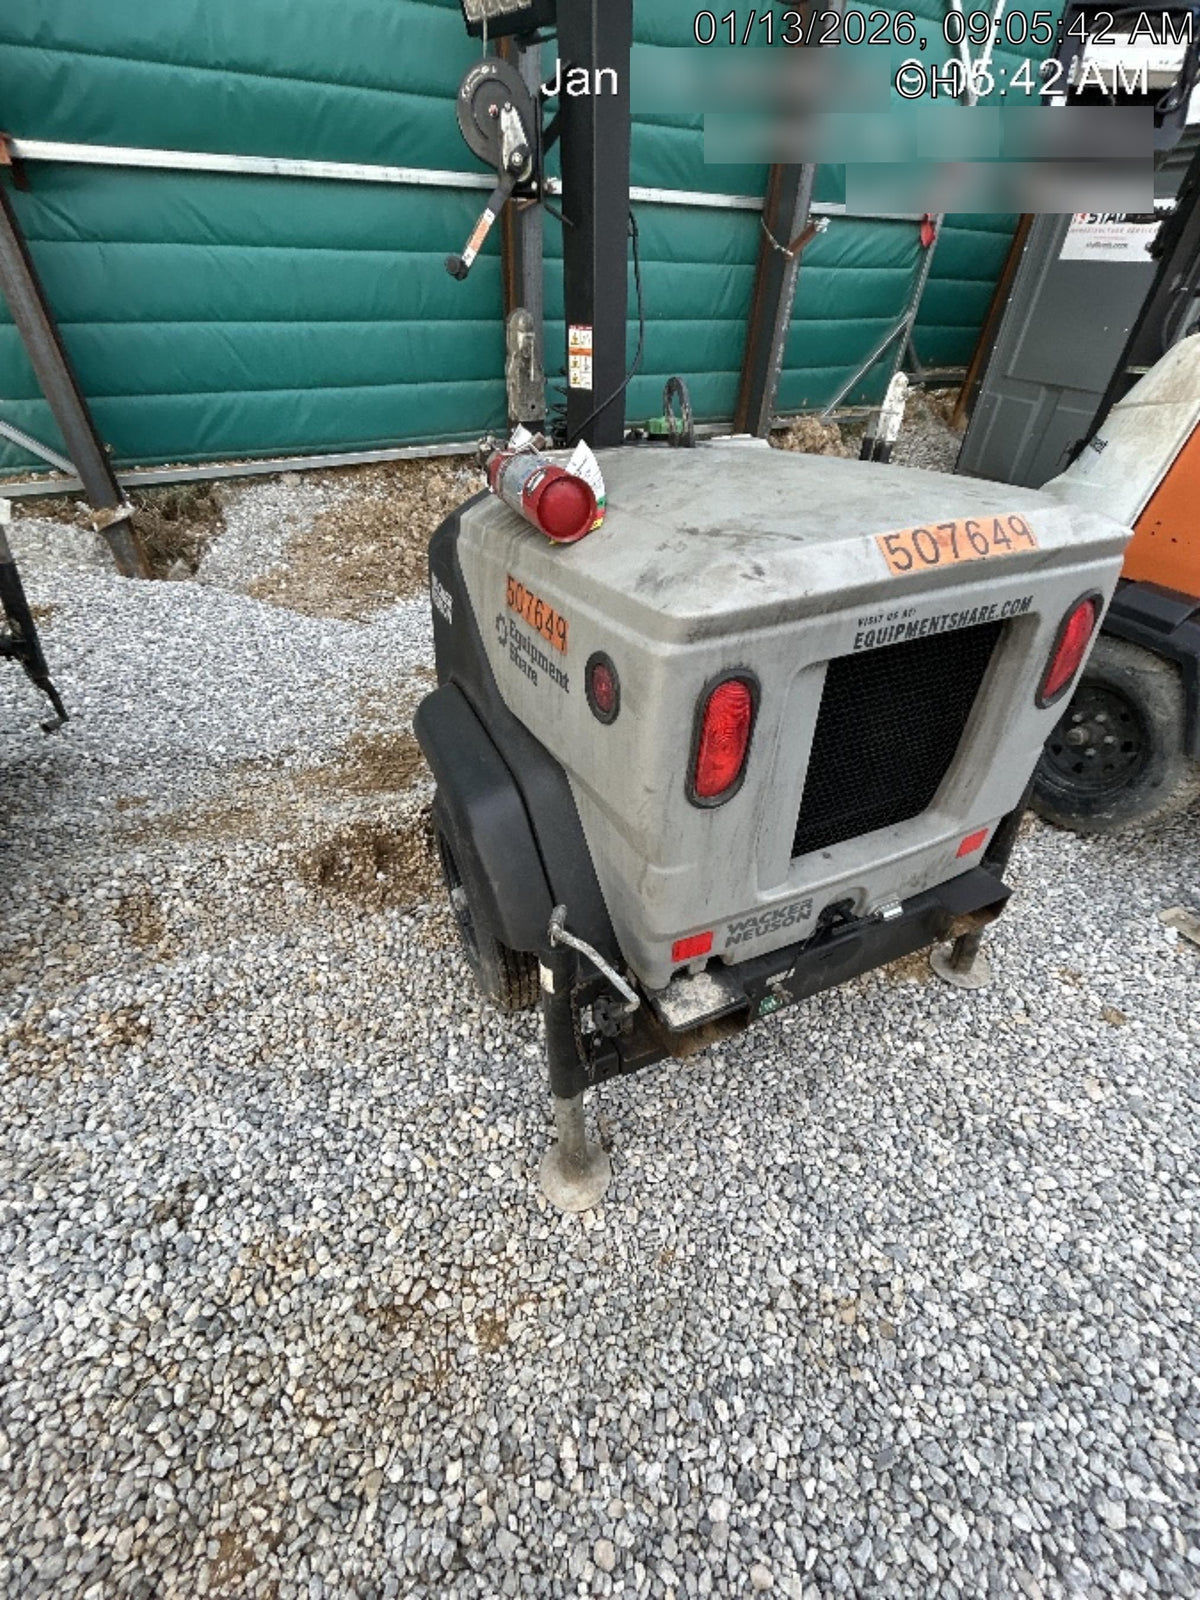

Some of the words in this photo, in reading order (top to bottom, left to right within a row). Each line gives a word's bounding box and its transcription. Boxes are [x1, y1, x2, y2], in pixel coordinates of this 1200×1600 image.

[882, 514, 1036, 571] 507649
[507, 574, 568, 652] 507649
[853, 595, 1034, 650] EQUIPMENTSHARE.COM
[508, 618, 570, 694] Equipment
[509, 642, 538, 688] Share
[725, 914, 810, 948] NEUSON
[727, 897, 813, 935] WACKER
